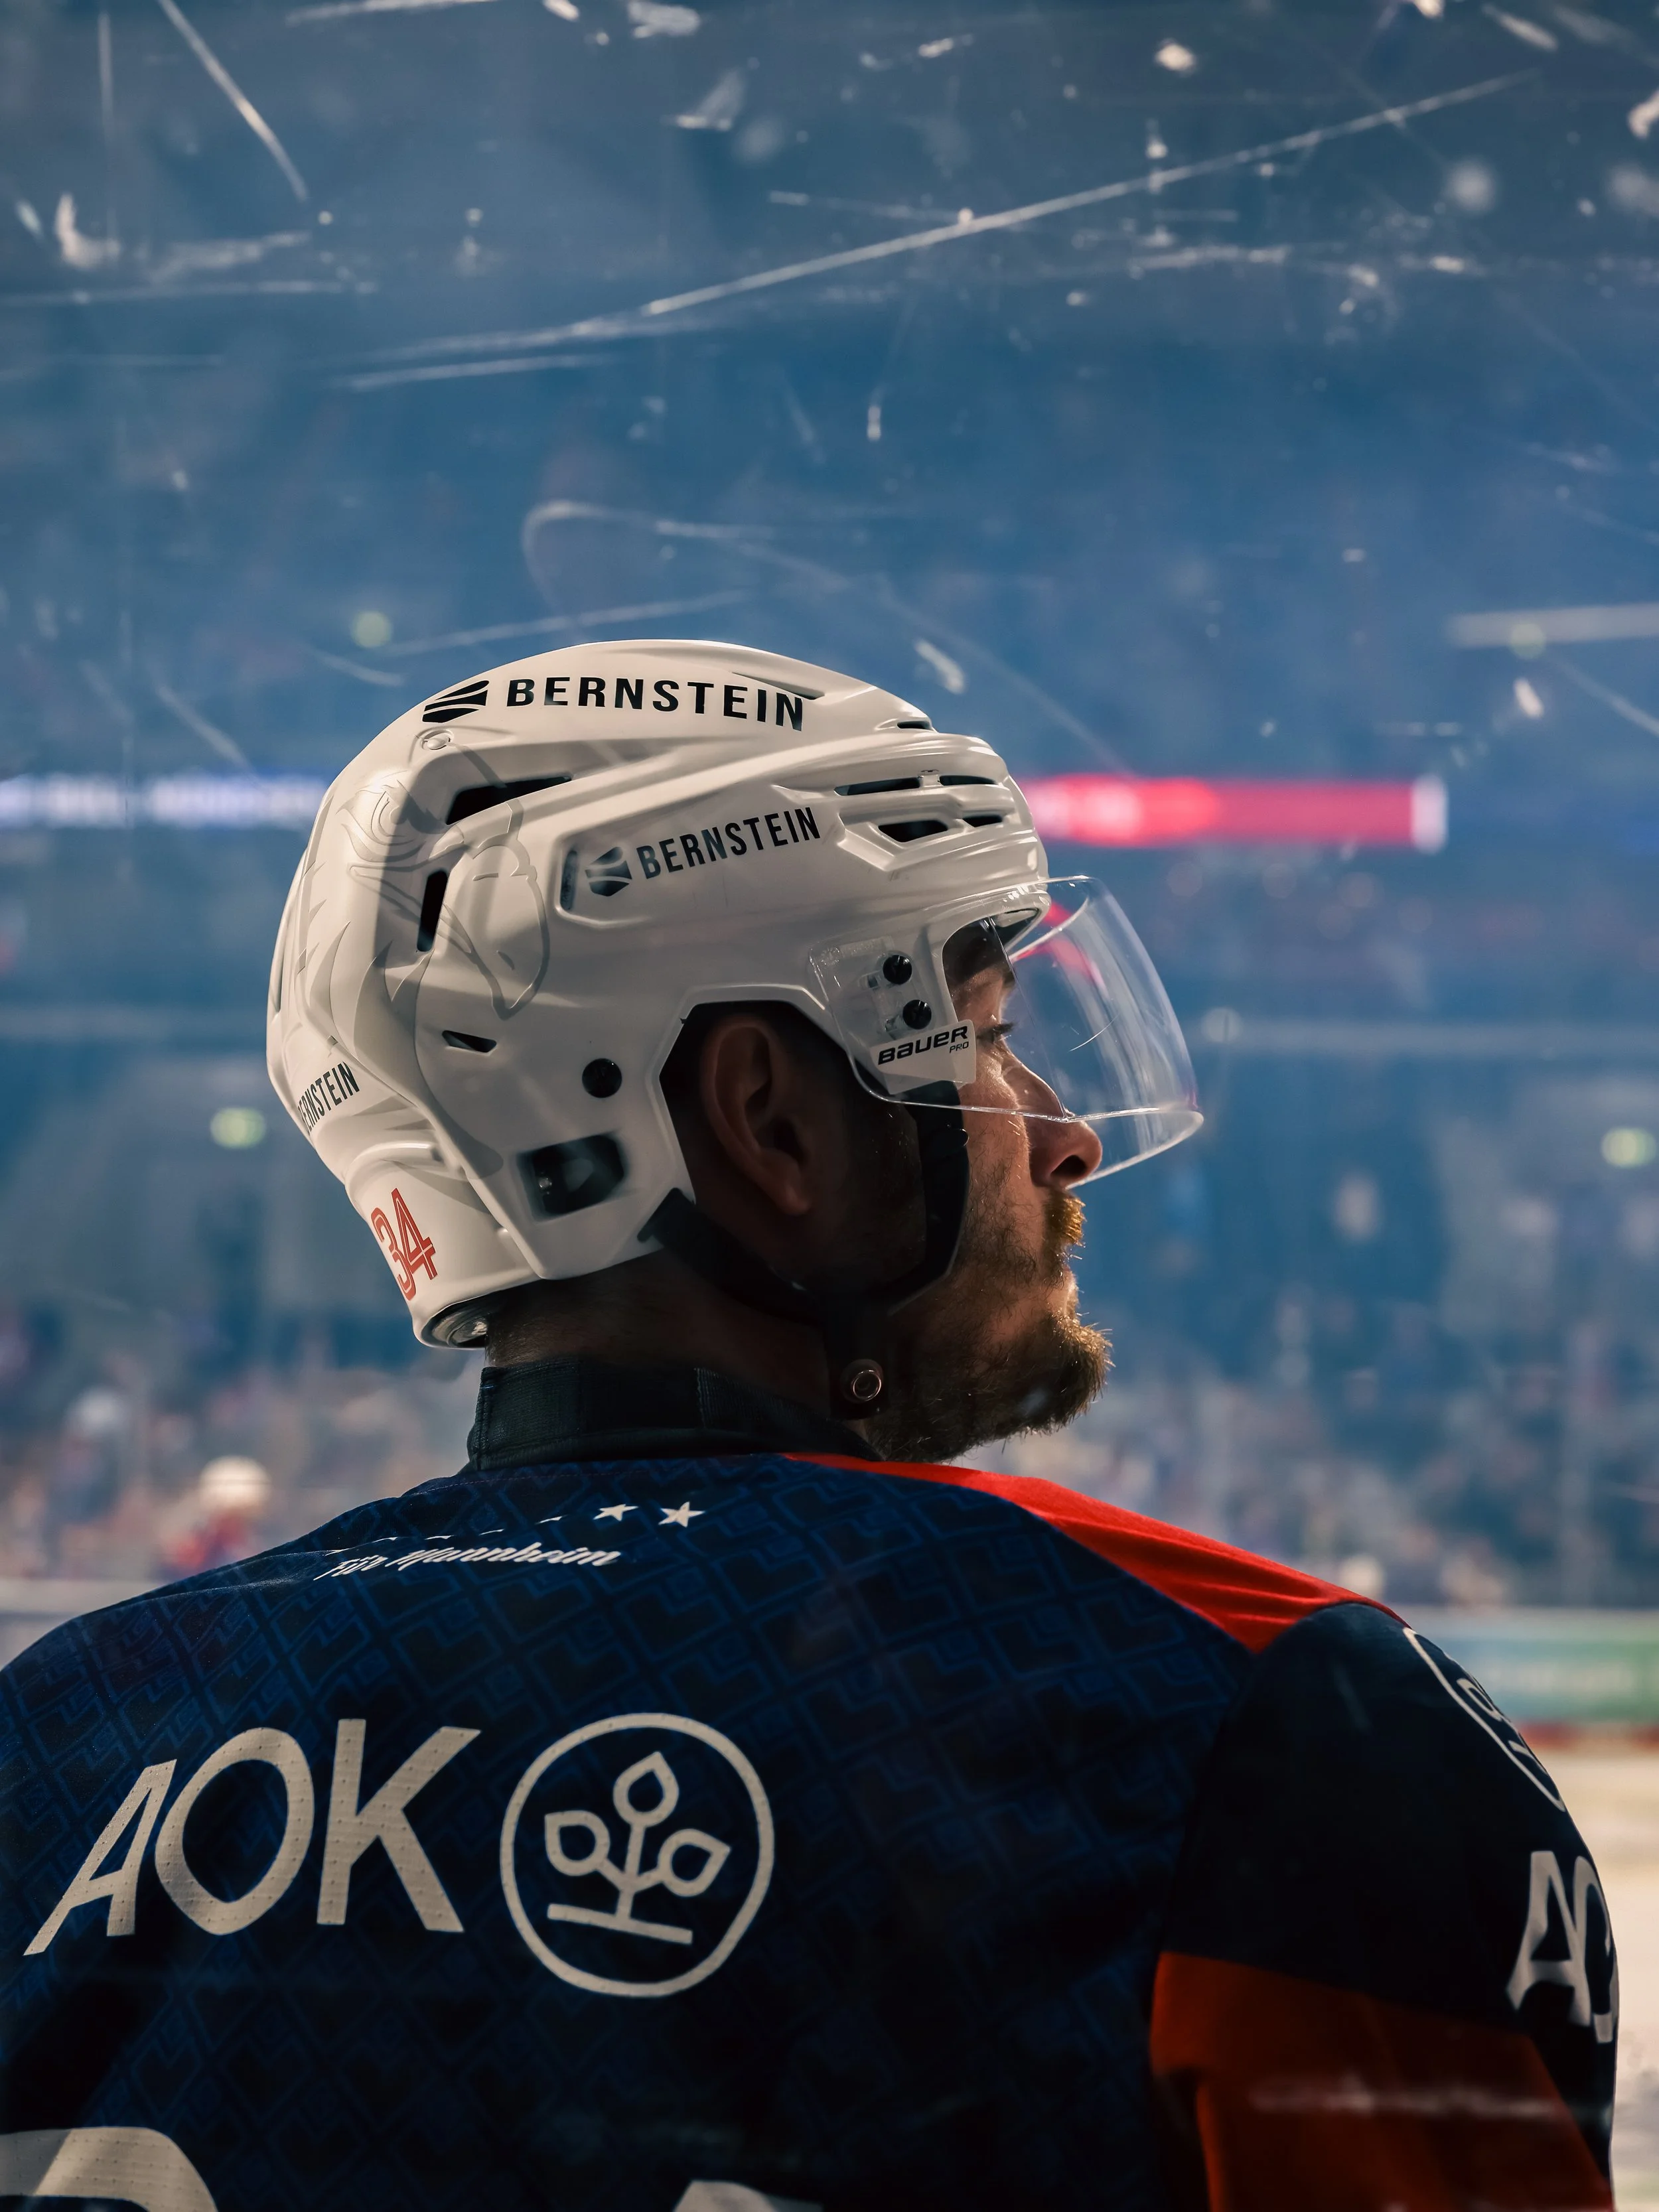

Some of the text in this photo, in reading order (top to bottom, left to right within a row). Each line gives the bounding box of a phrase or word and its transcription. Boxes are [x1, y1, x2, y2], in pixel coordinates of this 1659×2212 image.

[506, 676, 804, 732] BERNSTEIN
[636, 806, 822, 880] BERNSTEIN
[949, 1041, 970, 1054] PRO
[370, 1188, 438, 1302] 34
[22, 1718, 482, 1957] AOK
